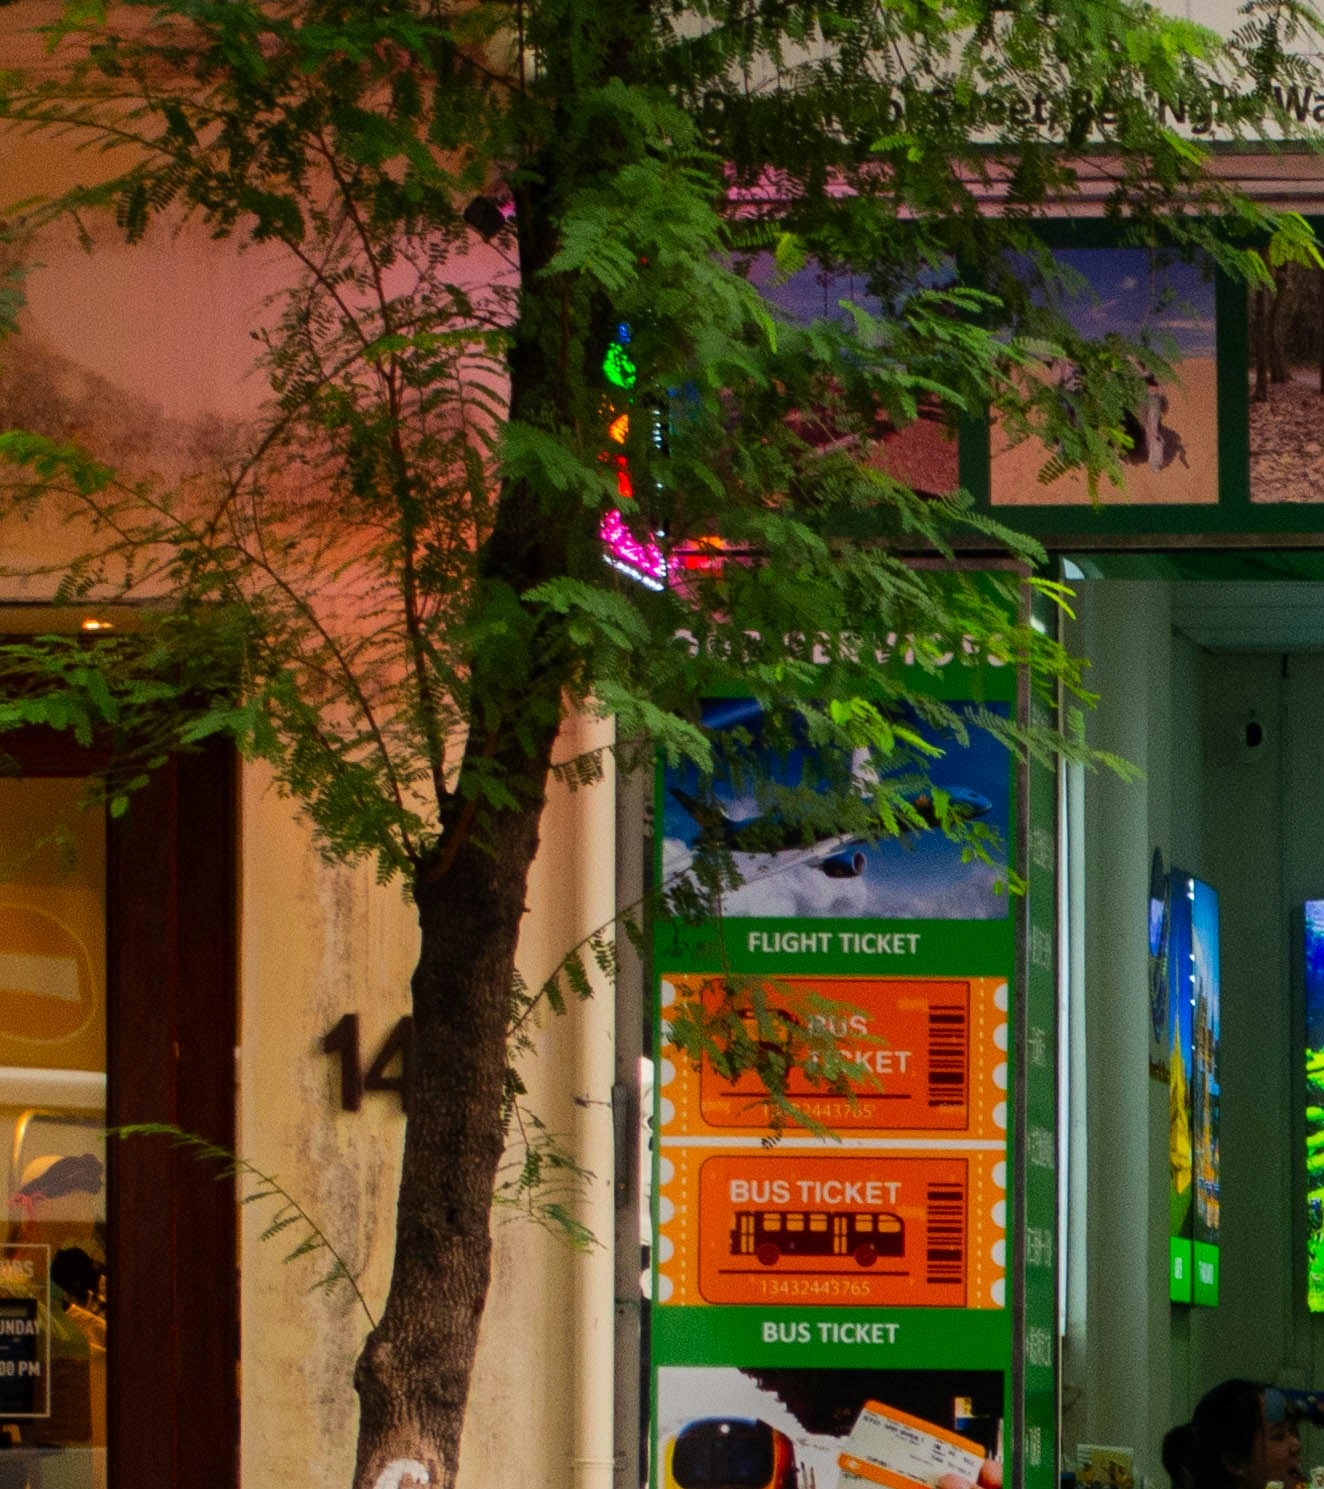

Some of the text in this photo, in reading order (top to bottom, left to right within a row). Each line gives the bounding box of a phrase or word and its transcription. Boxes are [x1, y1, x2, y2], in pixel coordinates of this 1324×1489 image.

[749, 932, 920, 953] FLIGHT TICKET
[730, 1180, 901, 1203] BUS TICKET
[762, 1322, 899, 1344] BUS TICKET
[18, 1361, 41, 1376] PM
